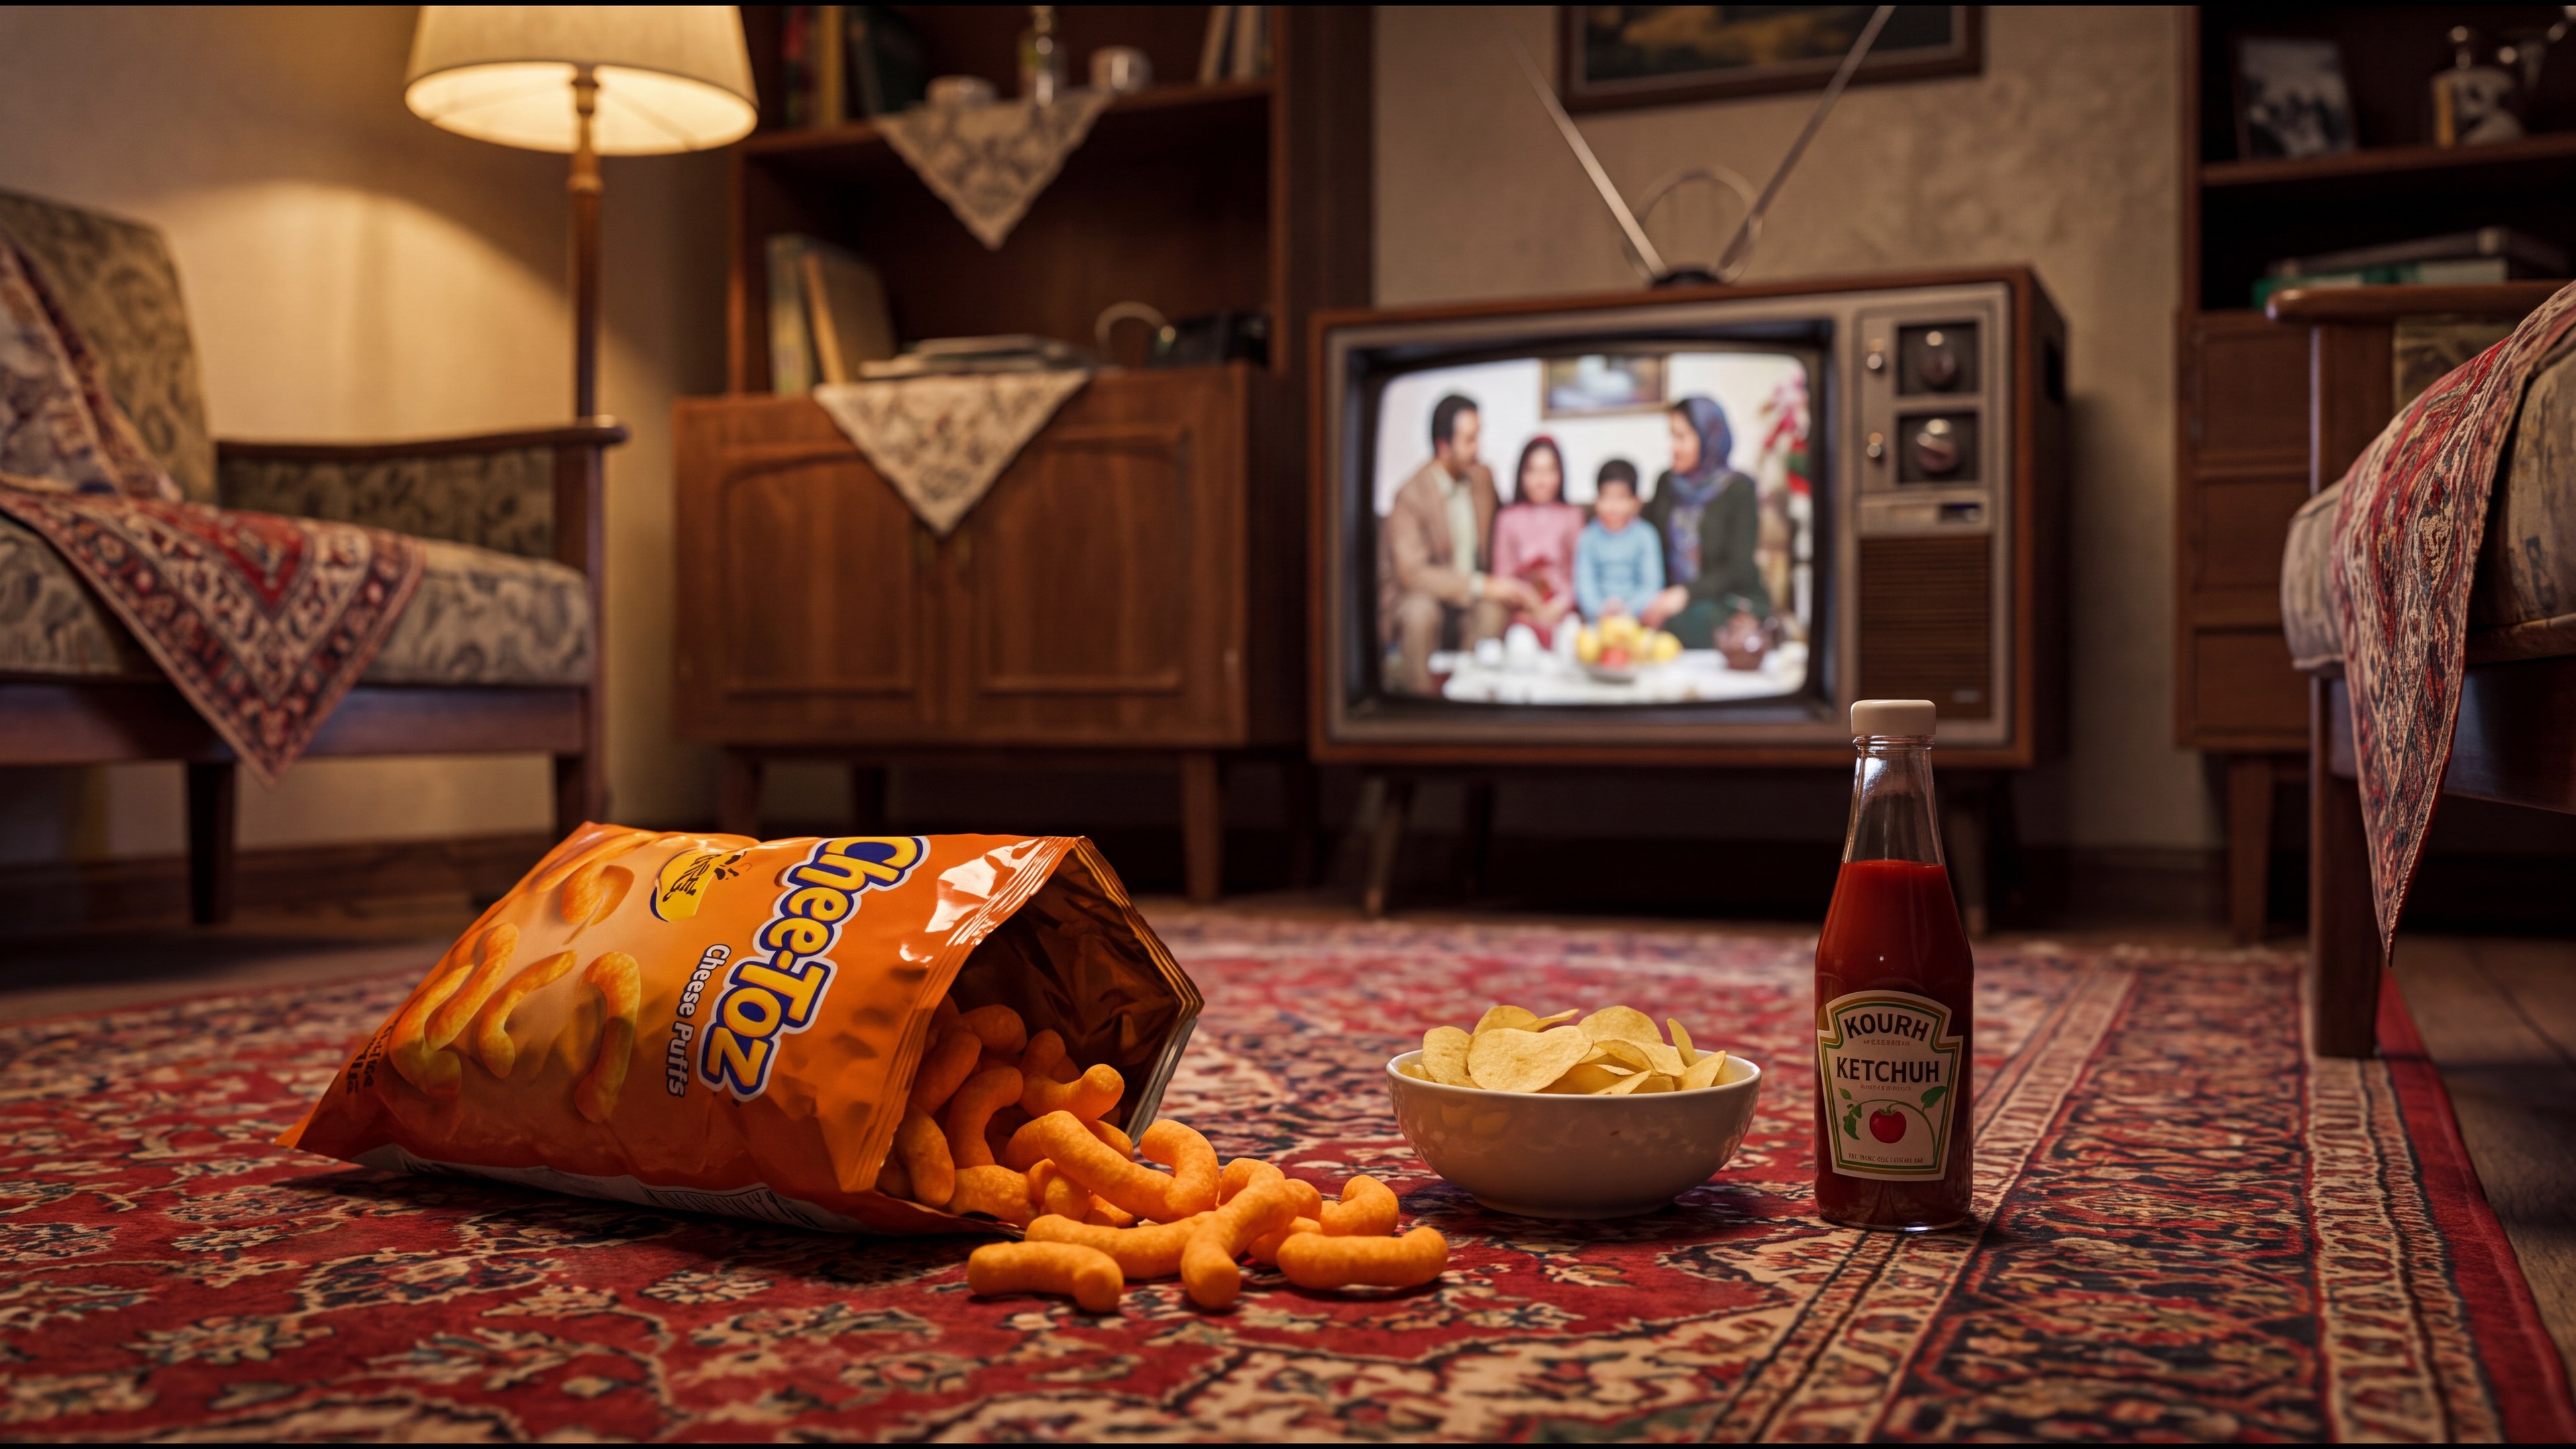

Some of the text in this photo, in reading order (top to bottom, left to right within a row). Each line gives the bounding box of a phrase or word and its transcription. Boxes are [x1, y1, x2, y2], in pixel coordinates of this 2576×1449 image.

[676, 944, 731, 1017] Cheese
[699, 837, 928, 1099] Chee-Toz
[665, 1022, 694, 1097] Puffs
[1843, 1013, 1930, 1042] KOURH
[1836, 1056, 1940, 1083] KETCHUH
